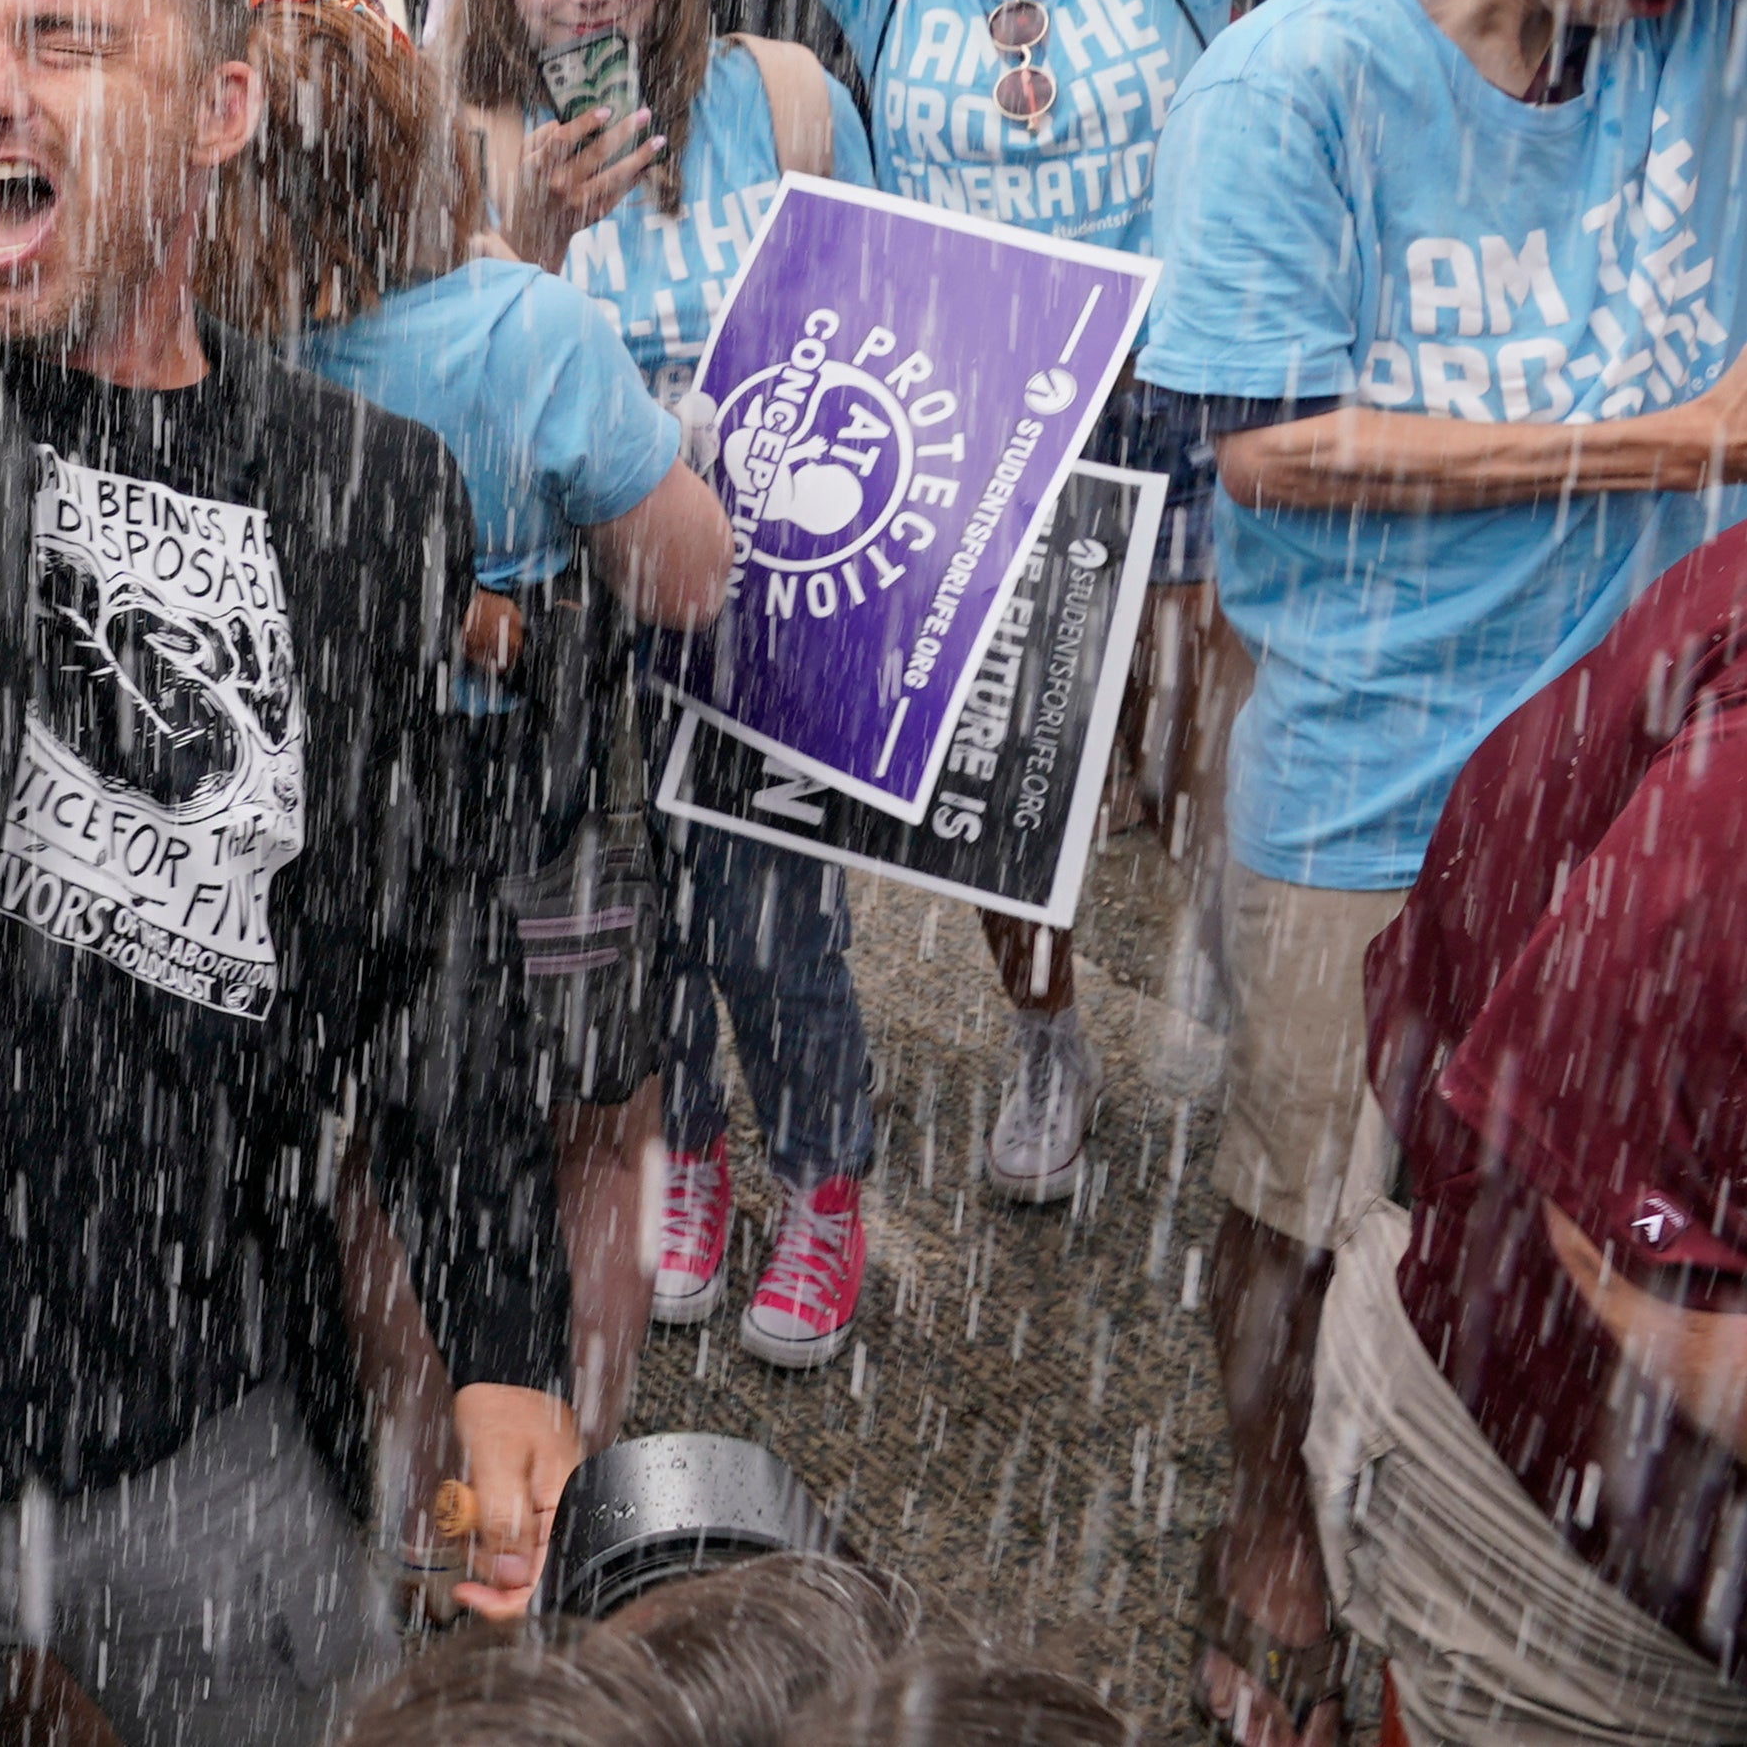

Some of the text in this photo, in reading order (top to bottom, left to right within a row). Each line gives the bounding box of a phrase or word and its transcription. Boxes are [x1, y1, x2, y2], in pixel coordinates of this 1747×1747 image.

[1406, 227, 1571, 337] AM
[725, 307, 841, 600] CONCEPTION
[765, 324, 966, 620] PROTECTION
[829, 401, 892, 477] AT
[57, 498, 289, 616] DISPOSABL
[96, 479, 227, 546] BEINGS
[903, 417, 1045, 691] STUDENTSFORLIFE.ORG
[1012, 567, 1097, 832] STUDENTSFORLIFE.ORG
[14, 755, 192, 889] TICE FOR
[932, 790, 988, 846] IS
[182, 865, 268, 946] FIVE
[168, 936, 277, 991] ABORTION
